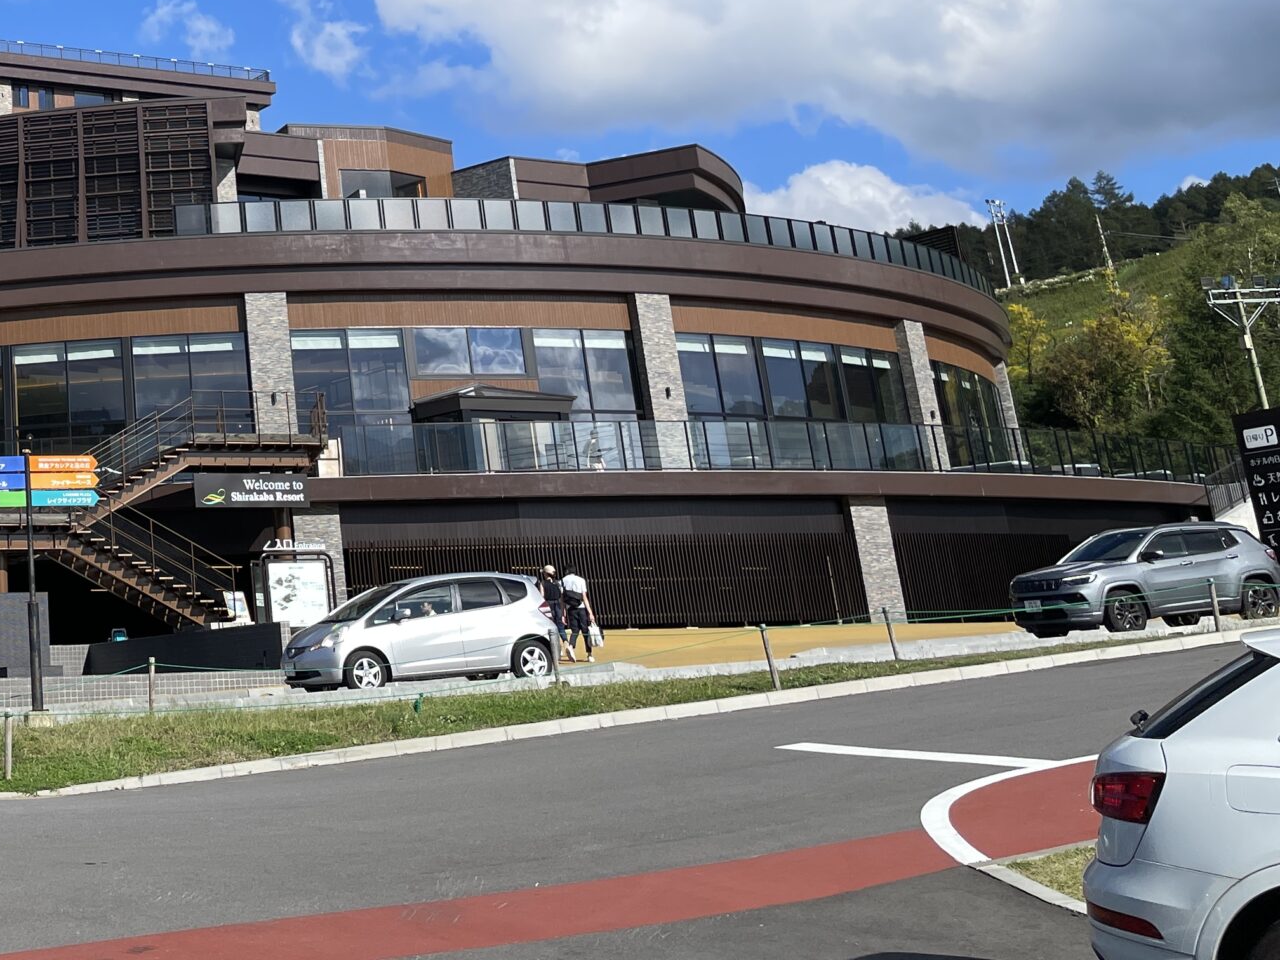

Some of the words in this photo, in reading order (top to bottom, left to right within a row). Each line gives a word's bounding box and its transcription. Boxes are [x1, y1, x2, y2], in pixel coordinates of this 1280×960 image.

[1264, 427, 1274, 443] P
[243, 479, 291, 491] Welcome
[292, 480, 304, 491] to
[231, 491, 275, 502] Shirakaba
[276, 491, 305, 502] Resort
[274, 538, 293, 550] 入口
[294, 542, 326, 550] Entrance
